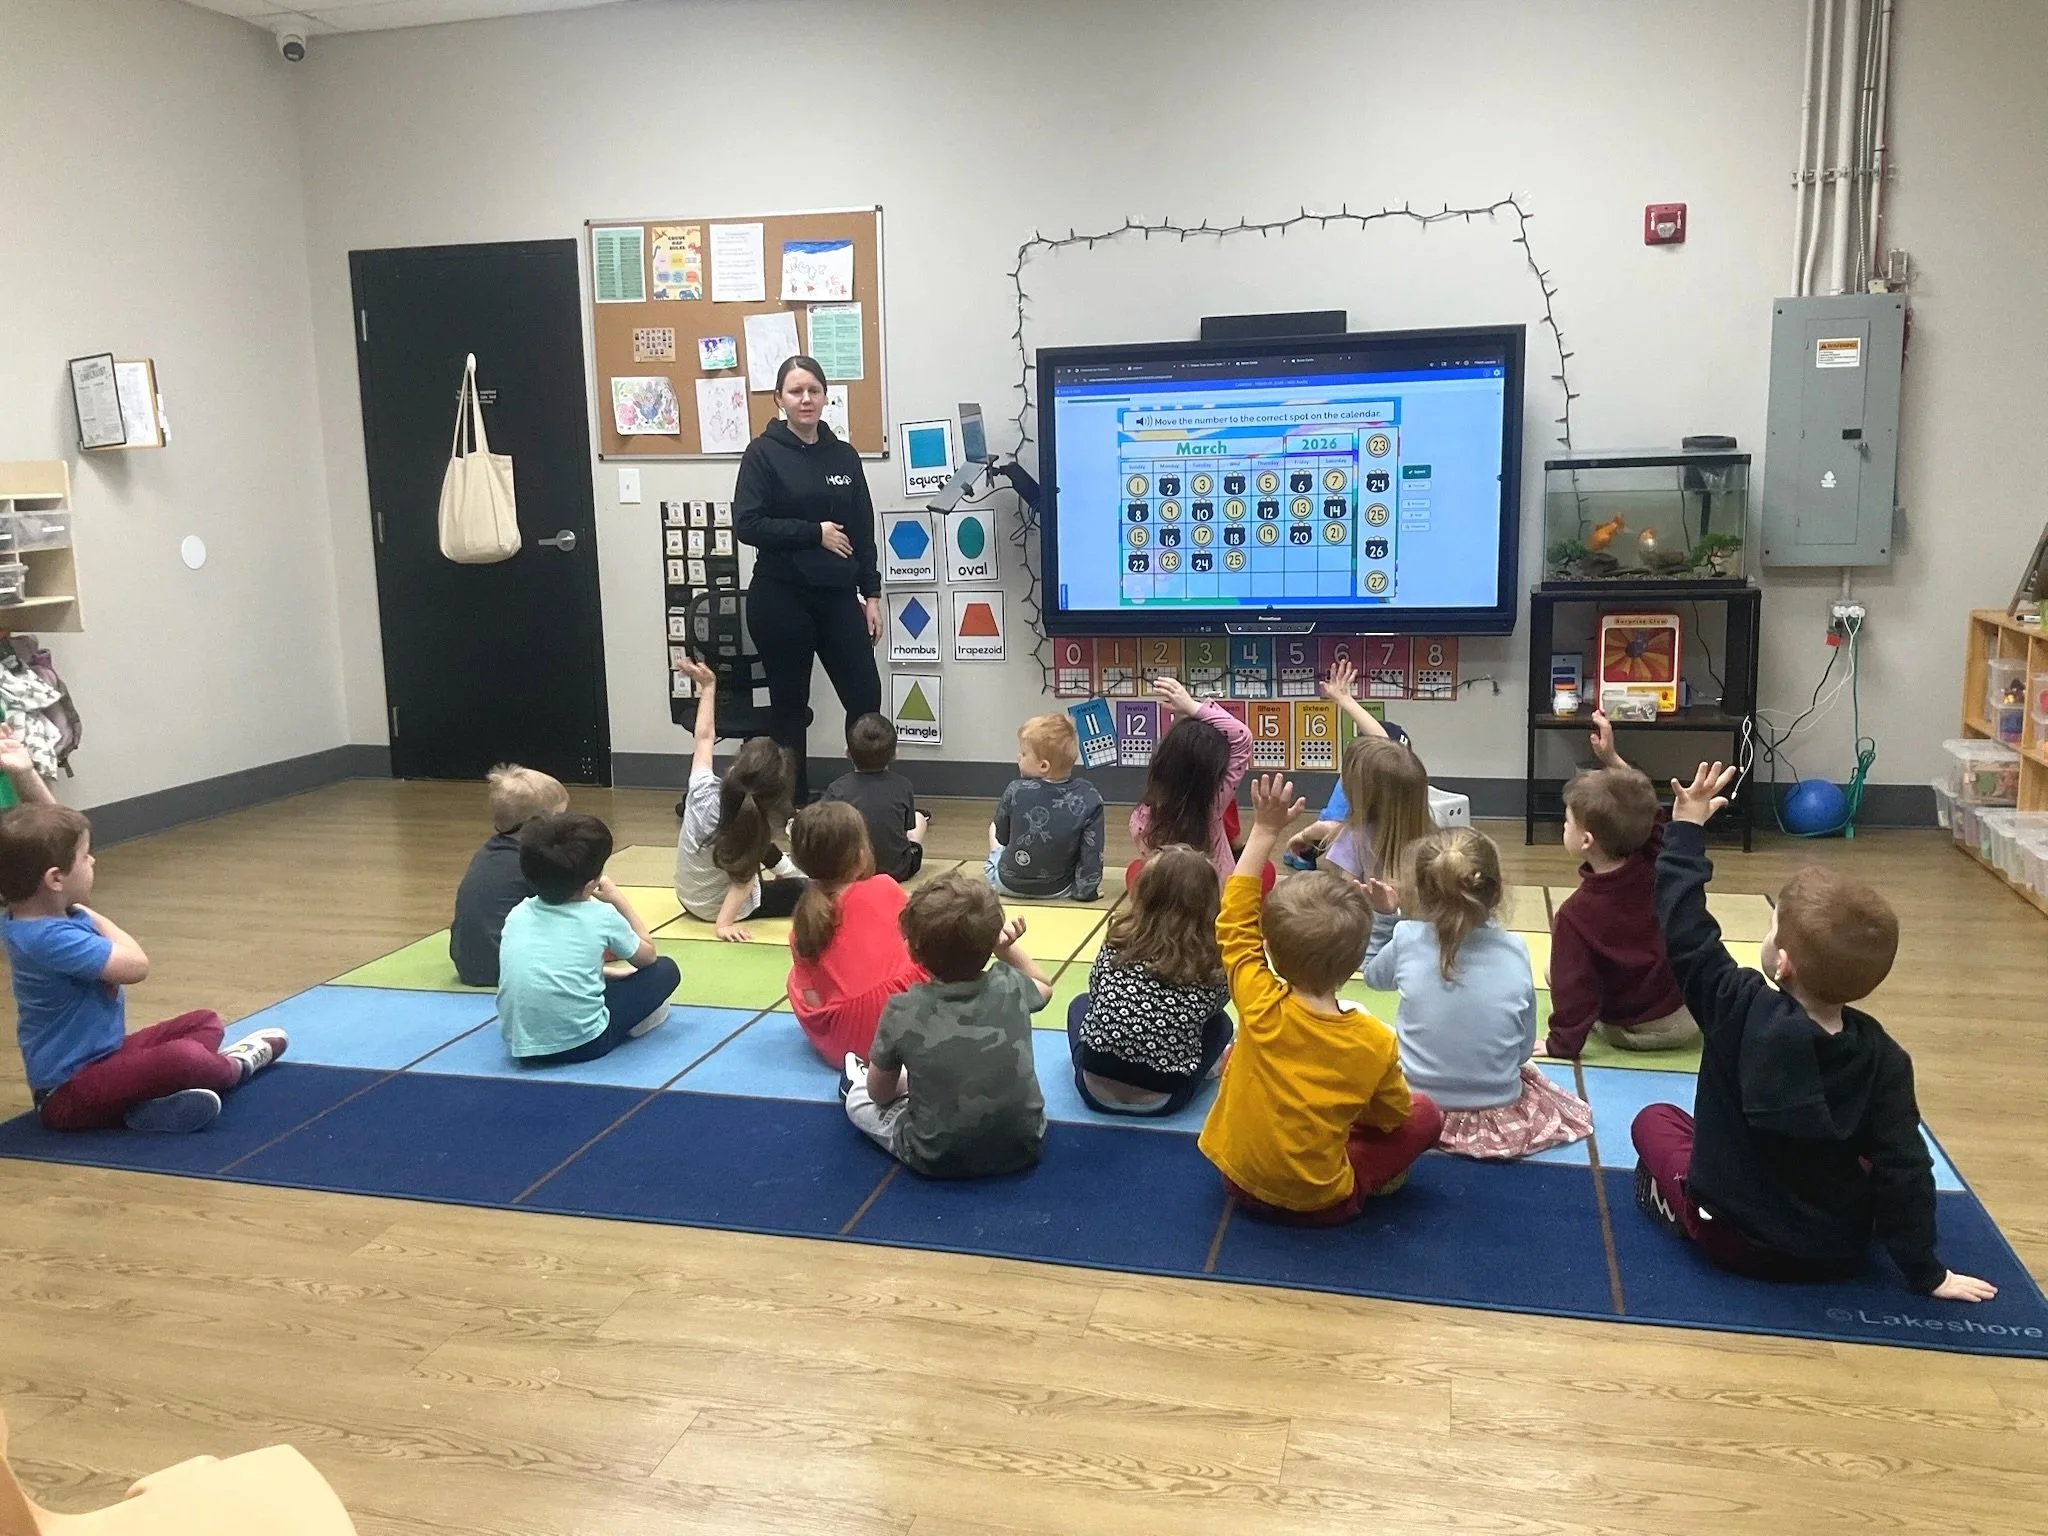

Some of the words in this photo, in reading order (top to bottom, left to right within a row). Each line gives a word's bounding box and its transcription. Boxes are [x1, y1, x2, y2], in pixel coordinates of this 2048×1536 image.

[1154, 418, 1177, 426] Move
[1179, 417, 1192, 425] the
[1194, 416, 1228, 425] number
[1240, 414, 1254, 423] the
[1256, 414, 1288, 422] correct
[1290, 412, 1308, 422] spot
[1324, 411, 1338, 420] the
[1341, 410, 1382, 419] calendar.
[1176, 441, 1227, 455] March
[1302, 438, 1337, 450] 2026
[1372, 440, 1386, 451] 23
[910, 474, 952, 488] square
[1136, 481, 1140, 491] 1
[1166, 484, 1173, 494] 2
[1200, 480, 1206, 490] 3
[1231, 482, 1238, 494] 4
[1264, 478, 1272, 488] 5
[1298, 480, 1305, 492] 6
[1332, 476, 1339, 486] 7
[1370, 479, 1385, 492] 24
[1135, 510, 1142, 521] 8
[1167, 506, 1173, 516] 9
[1196, 510, 1208, 520] 10
[1232, 504, 1238, 515] 11
[1264, 508, 1274, 518] 12
[1296, 502, 1307, 514] 13
[1330, 506, 1340, 516] 14
[1371, 510, 1384, 520] 25
[1134, 532, 1144, 542] 15
[1165, 535, 1176, 546] 16
[1198, 530, 1208, 541] 17
[1230, 534, 1240, 544] 18
[1263, 529, 1273, 540] 19
[1293, 532, 1308, 544] 20
[1330, 527, 1340, 538] 21
[1370, 546, 1384, 558] 26
[890, 566, 930, 576] hexagon
[958, 562, 988, 577] oval
[1132, 560, 1145, 572] 22
[1164, 556, 1177, 566] 23
[1196, 559, 1209, 570] 24
[1228, 555, 1242, 566] 25
[1371, 577, 1384, 588] 27
[894, 644, 936, 654] rhombus
[958, 645, 1002, 656] trapezoid
[1066, 643, 1082, 665] 0
[1114, 642, 1120, 664] 1
[1153, 642, 1169, 664] 2
[1198, 642, 1212, 664] 3
[1242, 642, 1259, 664] 4
[1289, 643, 1304, 665] 5
[1334, 643, 1350, 664] 6
[1380, 643, 1394, 666] 7
[1428, 644, 1444, 667] 8
[1077, 703, 1101, 714] eleven
[1124, 704, 1148, 712] twelve
[896, 724, 938, 738] triangle
[1085, 713, 1100, 736] 11
[1126, 714, 1147, 736] 12
[1258, 714, 1280, 737] 15
[1305, 714, 1328, 737] 16
[1859, 1309, 2042, 1338] Lakeshore
